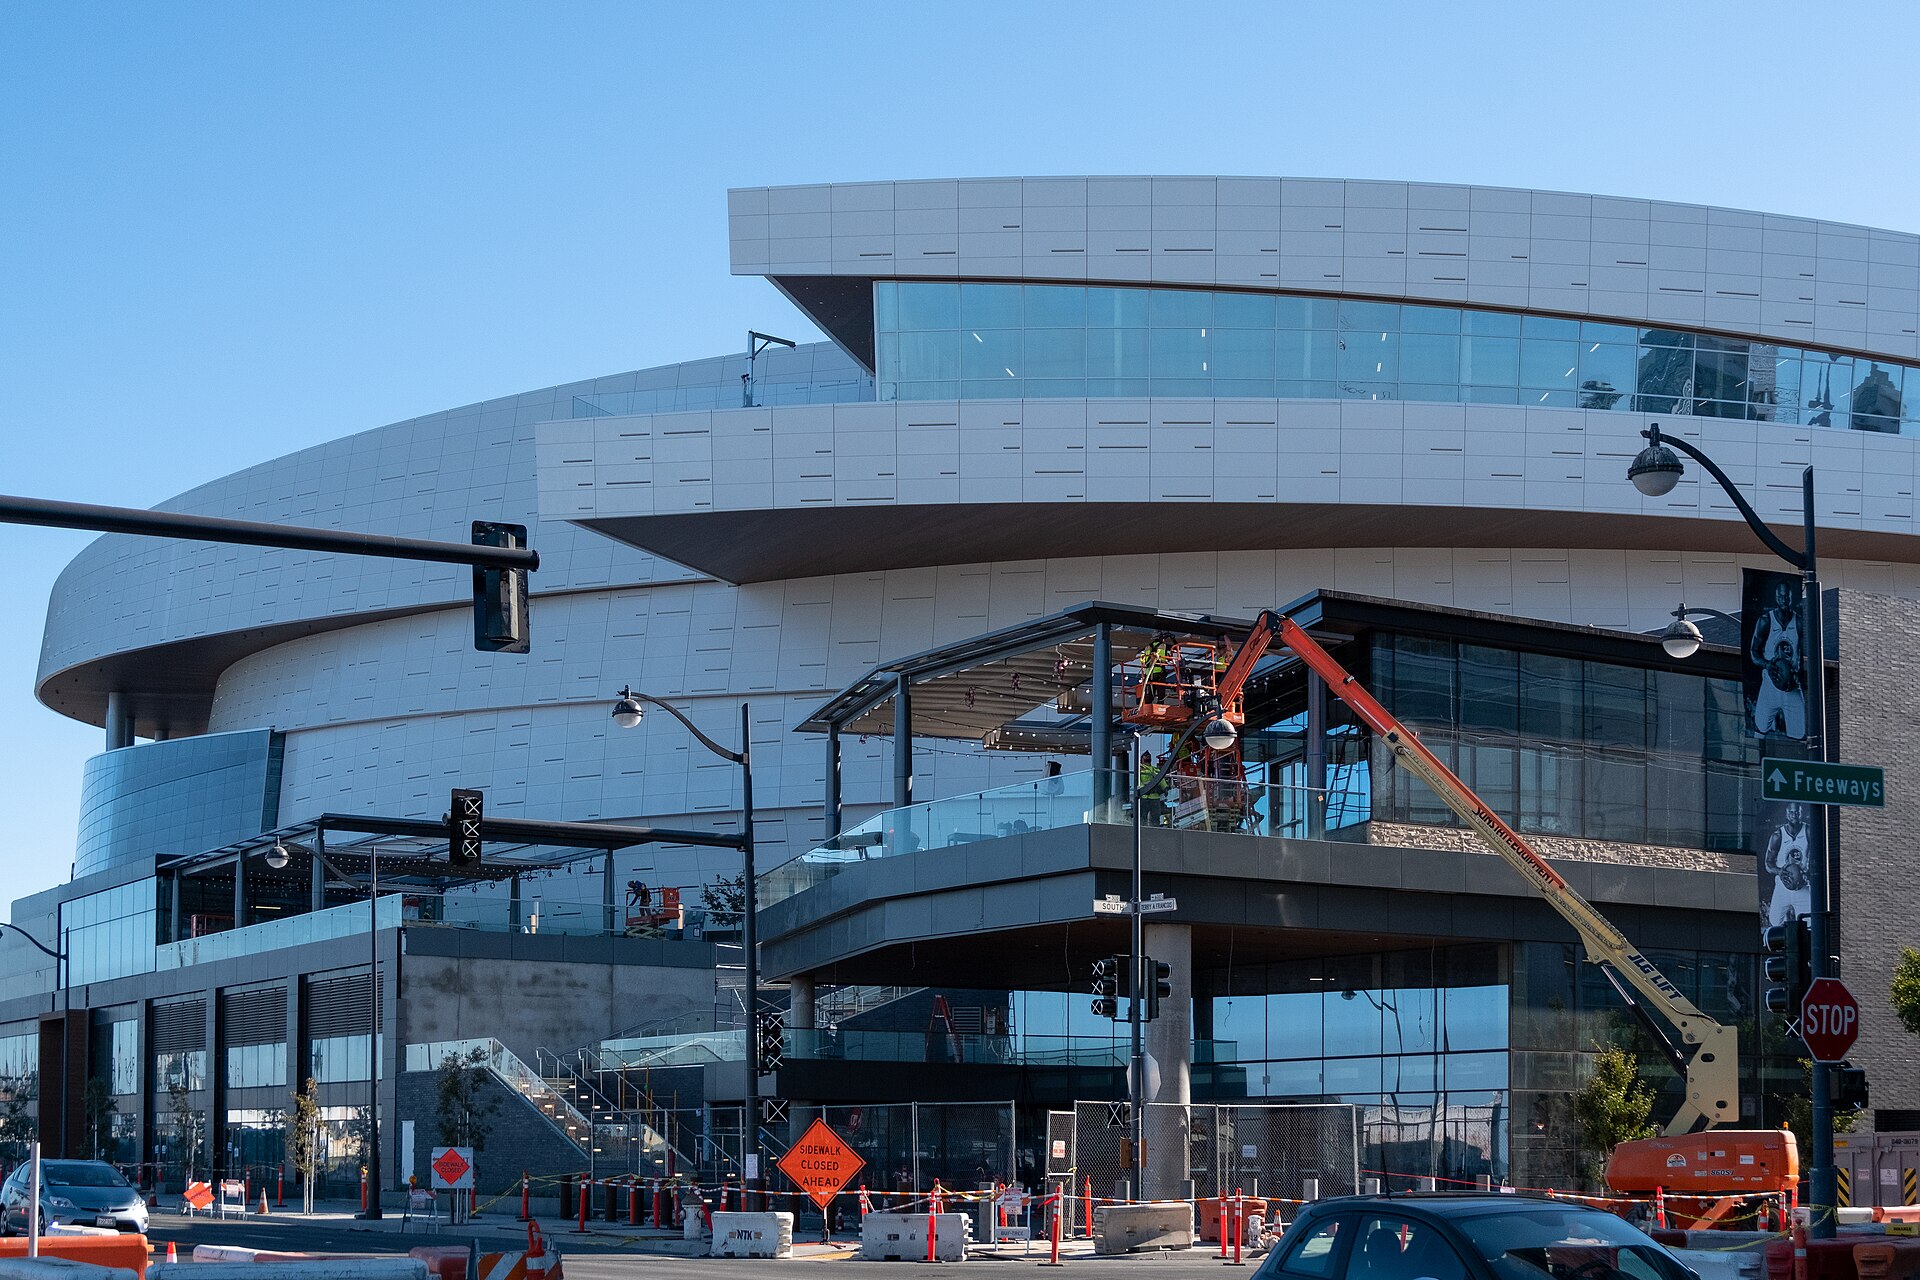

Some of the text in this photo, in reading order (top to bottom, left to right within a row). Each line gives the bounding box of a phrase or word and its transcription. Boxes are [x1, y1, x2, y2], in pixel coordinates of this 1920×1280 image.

[1794, 771, 1880, 801] Freeways
[1472, 806, 1554, 885] SUNSTATE EQUIPMENT
[1102, 903, 1125, 911] SOUTH
[1156, 901, 1173, 909] FRANCOIS
[1627, 954, 1682, 999] JLG LIFT
[1806, 1004, 1856, 1035] STOP
[800, 1145, 841, 1156] SIDEWALK
[801, 1160, 839, 1171] CLOSED
[802, 1176, 840, 1187] AHEAD
[736, 1229, 753, 1241] NTK
